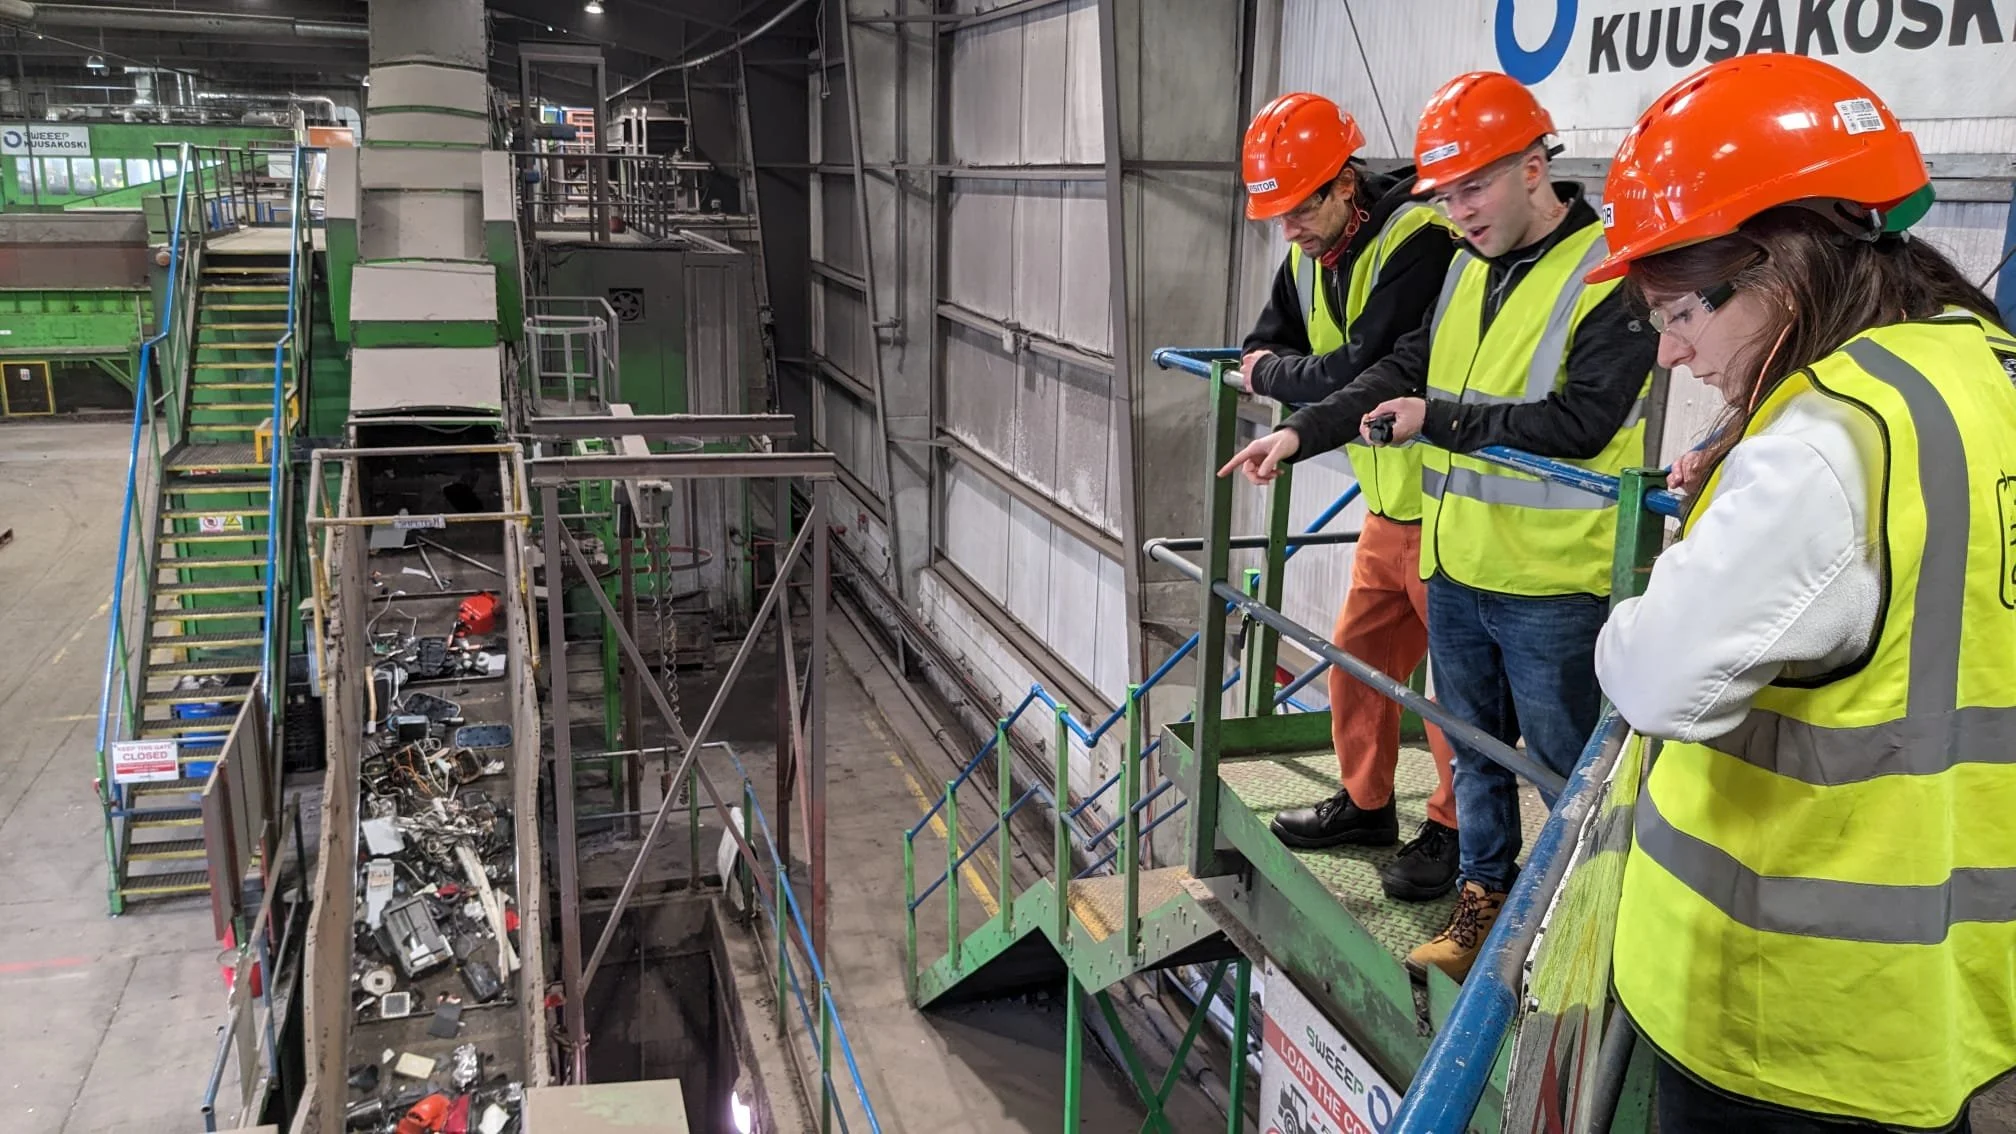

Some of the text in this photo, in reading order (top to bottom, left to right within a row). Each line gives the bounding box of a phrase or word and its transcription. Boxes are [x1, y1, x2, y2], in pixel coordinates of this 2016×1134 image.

[1588, 0, 2016, 74] KUUSAKOSK
[122, 750, 168, 761] CLOSED
[1280, 1036, 1313, 1086] LOAD
[1315, 1077, 1341, 1120] THE
[1306, 1025, 1364, 1095] SWEEEP
